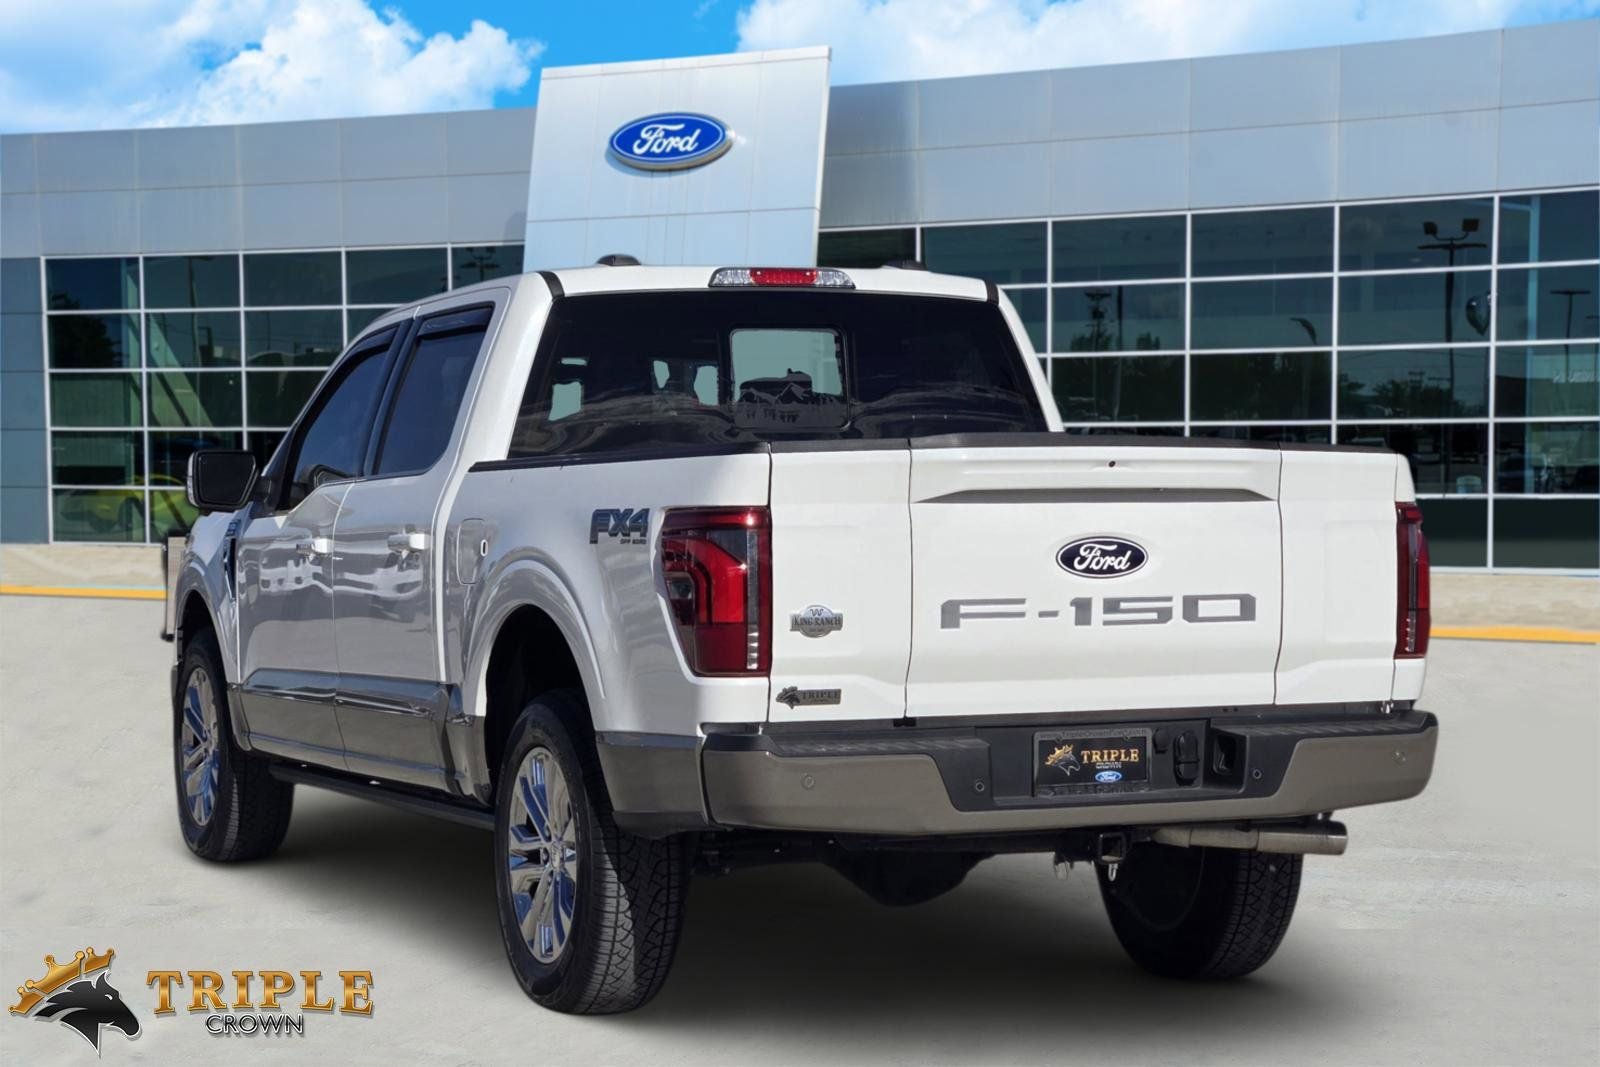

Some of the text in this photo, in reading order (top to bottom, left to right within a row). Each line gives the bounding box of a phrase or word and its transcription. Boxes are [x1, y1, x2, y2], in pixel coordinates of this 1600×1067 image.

[632, 123, 701, 155] Ford
[589, 508, 650, 544] FX4
[1073, 543, 1132, 570] Ford
[793, 616, 841, 626] KING RANCH
[940, 593, 1256, 629] F-150
[802, 690, 841, 700] TRIPLE
[1080, 748, 1140, 764] TRIPLE
